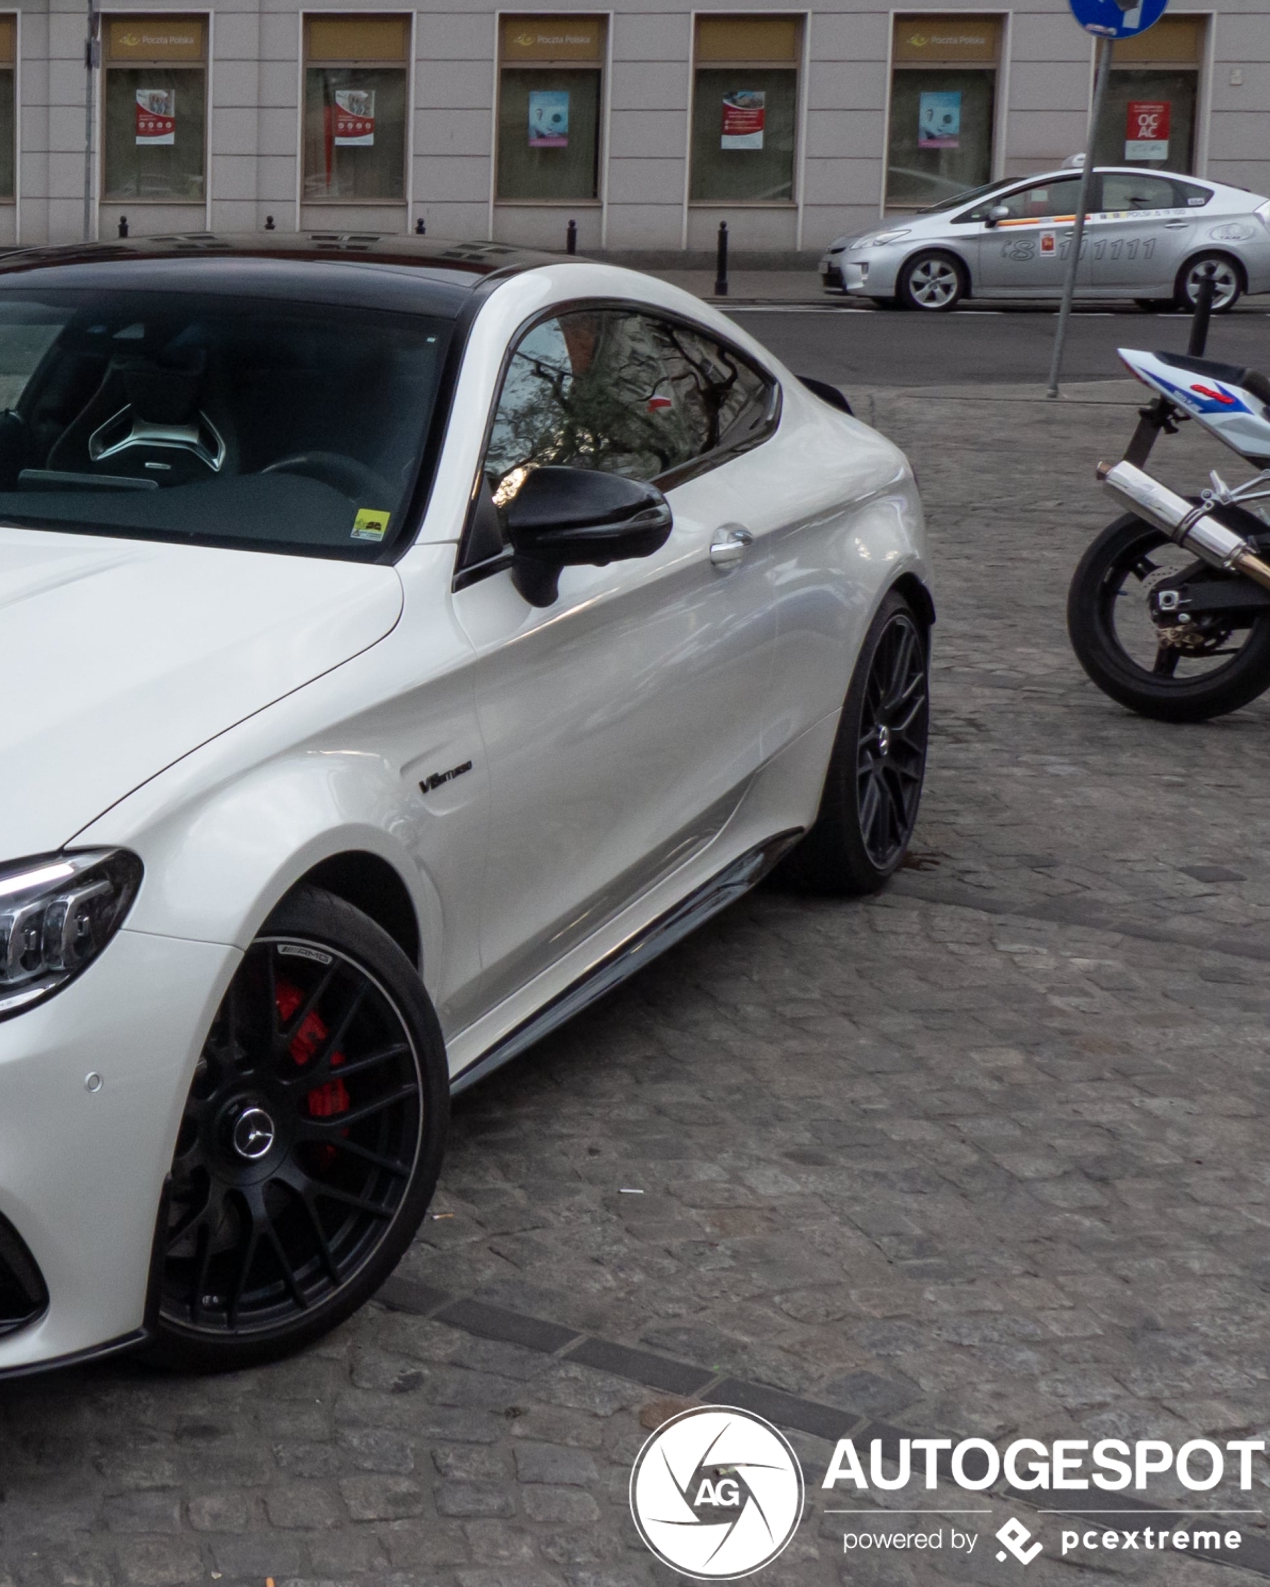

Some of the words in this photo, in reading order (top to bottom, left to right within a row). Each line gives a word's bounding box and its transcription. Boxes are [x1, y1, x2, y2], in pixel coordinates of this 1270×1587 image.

[1138, 114, 1158, 126] OC
[1138, 126, 1157, 138] AC
[1009, 239, 1036, 261] 8
